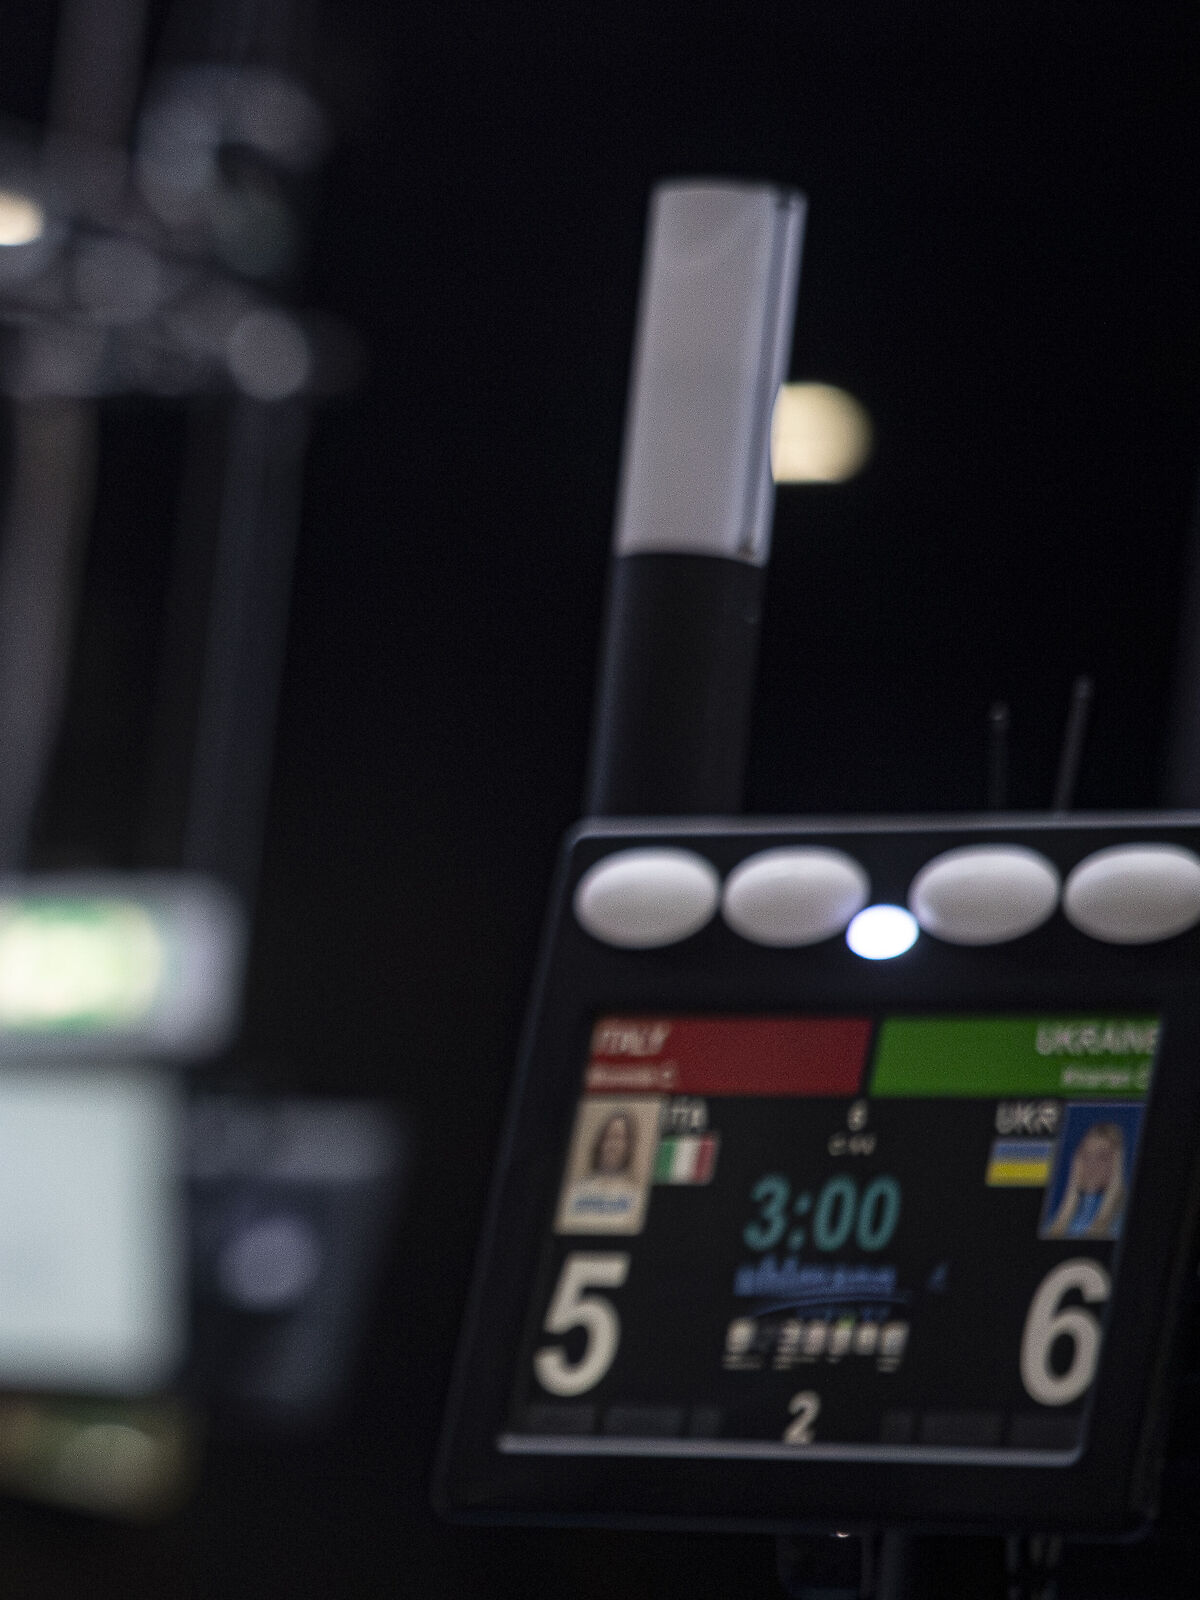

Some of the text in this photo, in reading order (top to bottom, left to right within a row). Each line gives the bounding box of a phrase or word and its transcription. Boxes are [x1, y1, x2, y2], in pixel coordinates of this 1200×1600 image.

[743, 1172, 900, 1251] 3:00
[533, 1251, 631, 1397] 5
[1019, 1257, 1111, 1406] 6
[784, 1389, 821, 1445] 2
